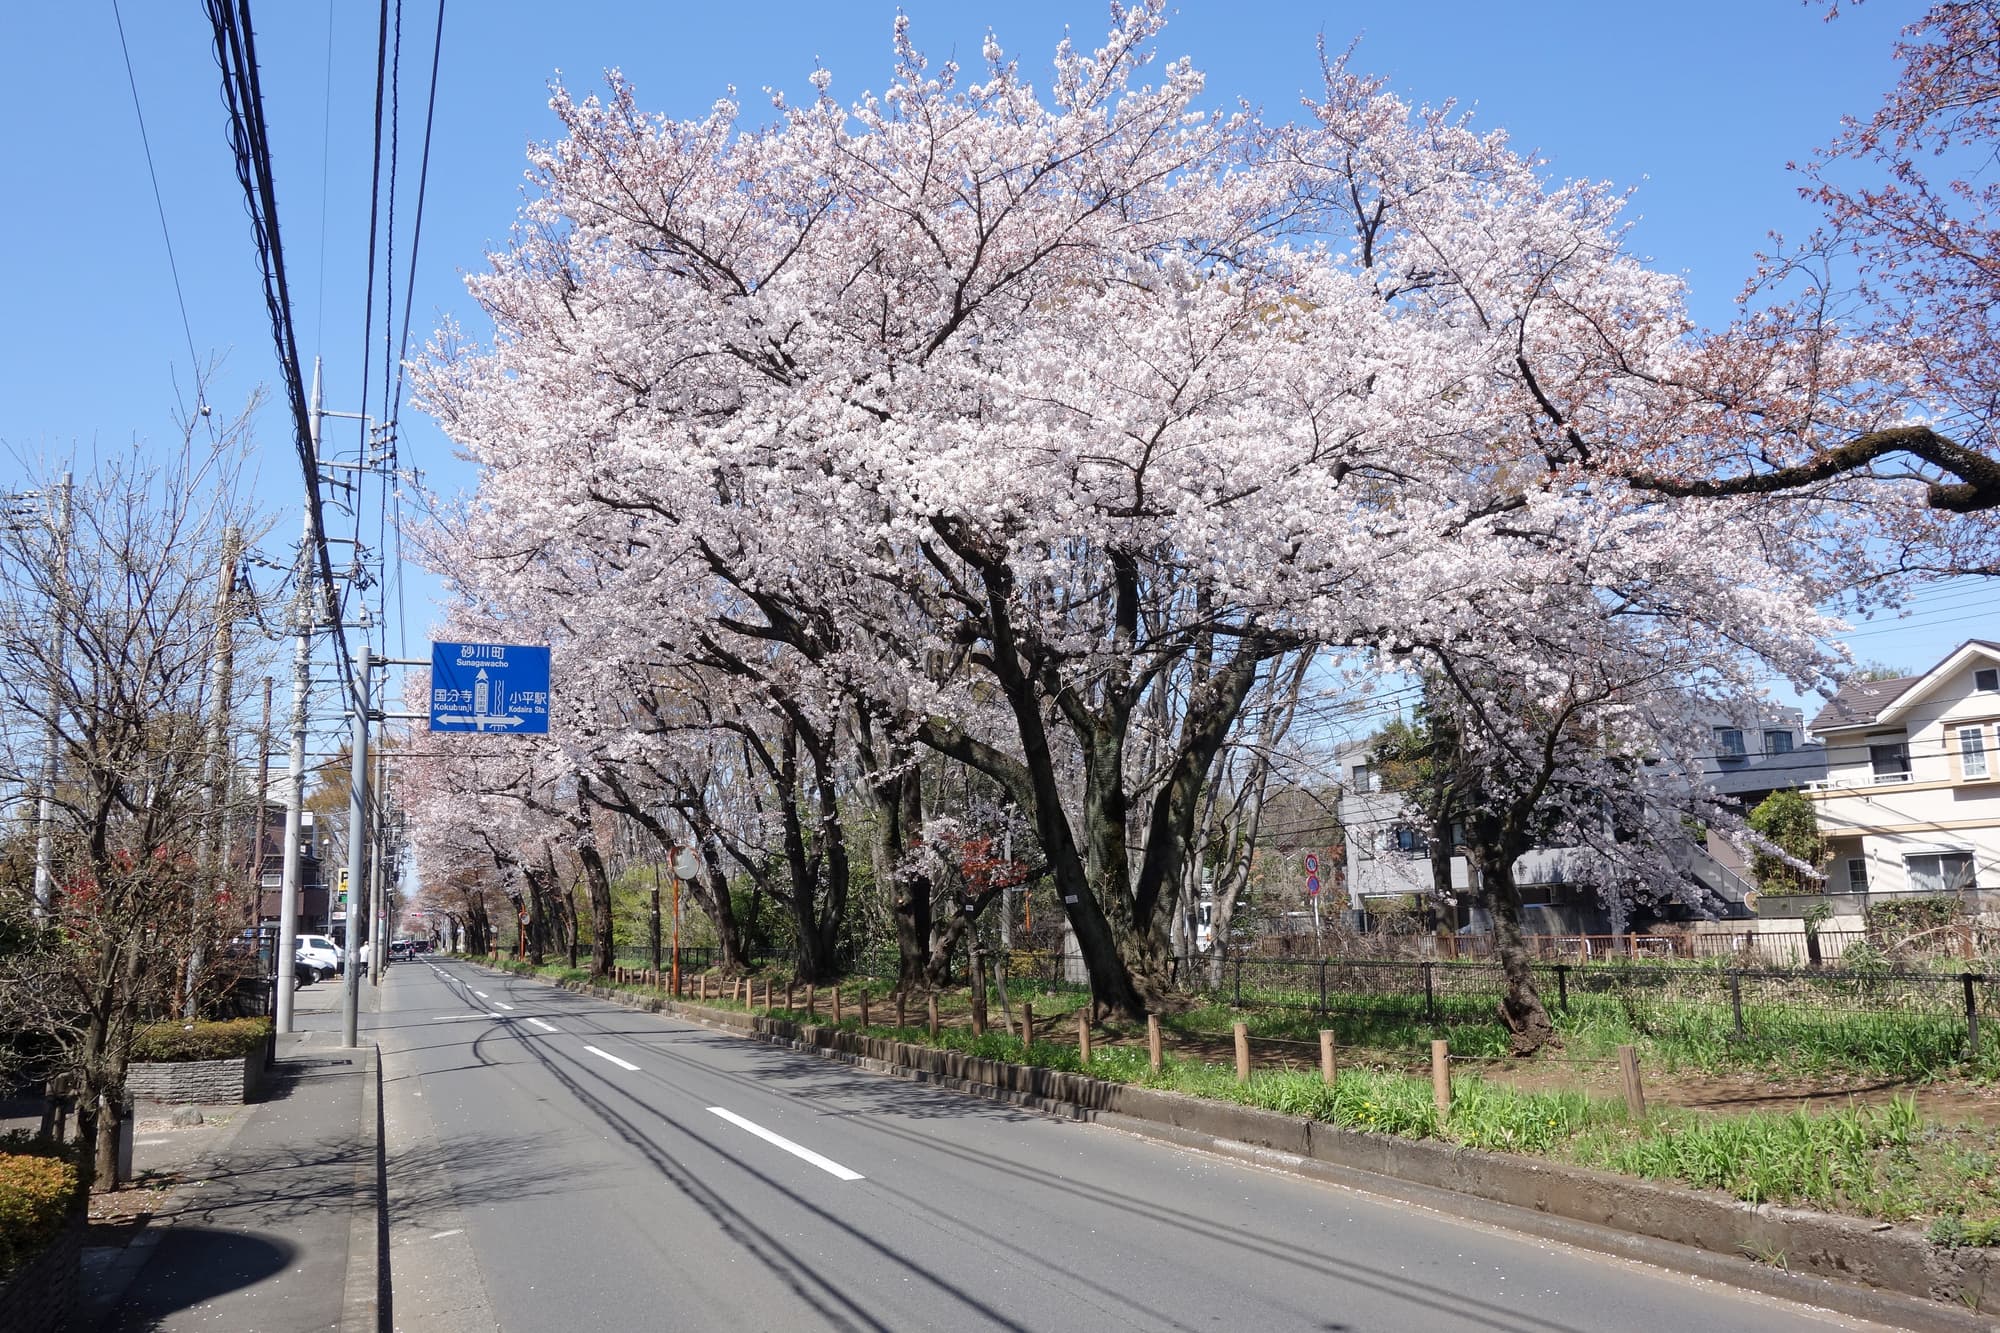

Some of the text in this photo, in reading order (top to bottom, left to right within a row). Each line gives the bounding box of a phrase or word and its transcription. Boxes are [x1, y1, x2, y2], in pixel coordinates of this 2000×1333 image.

[461, 645, 505, 660] 砂川町
[456, 659, 509, 668] Sunagawacho
[434, 688, 473, 703] 国分寺
[509, 691, 547, 705] 小平駅
[434, 704, 472, 712] Kokubunji
[508, 705, 547, 713] Kodaira Sta.
